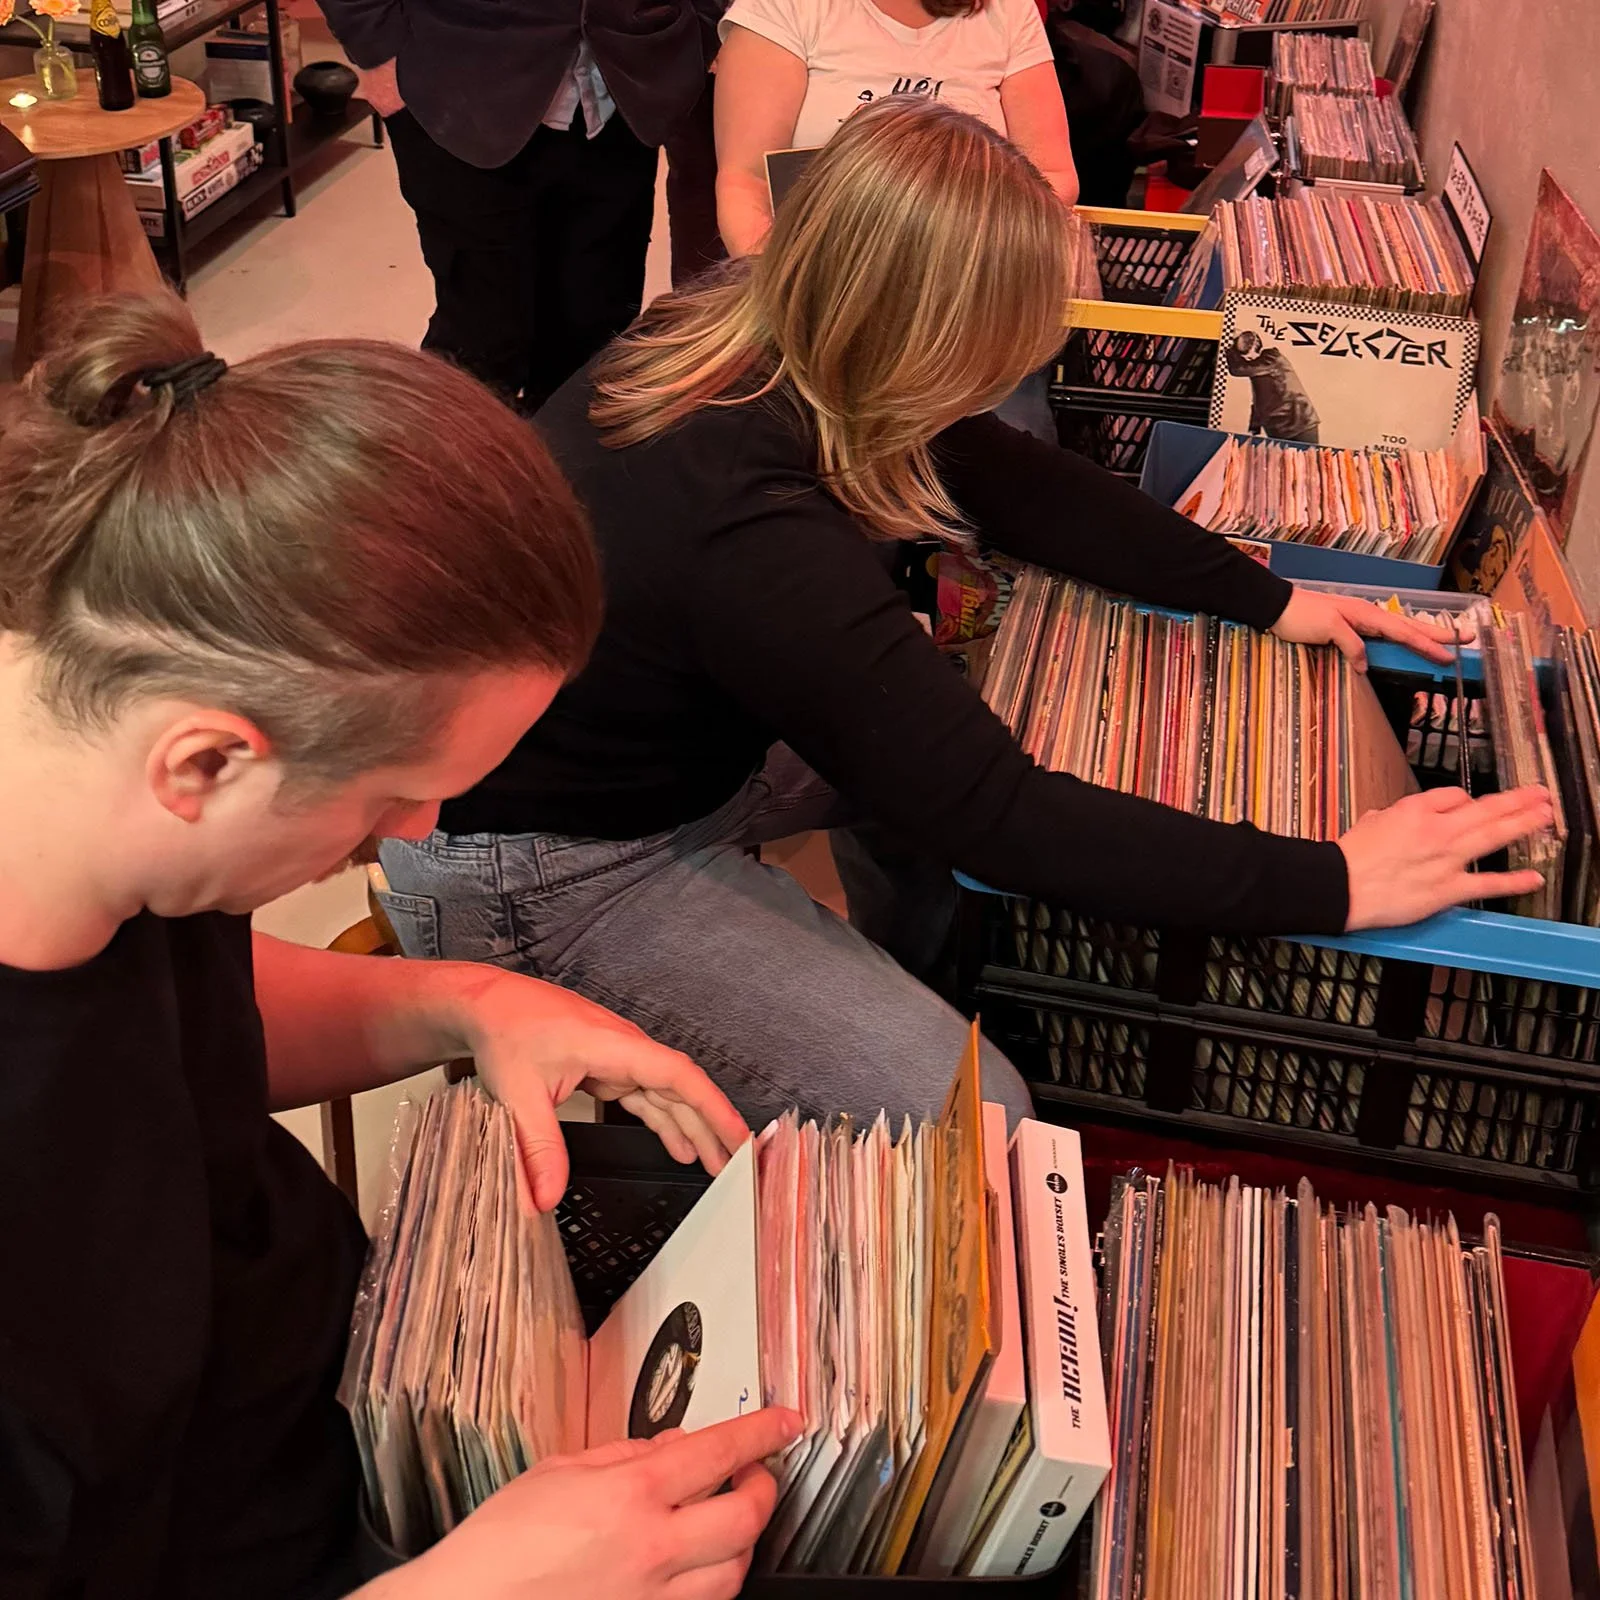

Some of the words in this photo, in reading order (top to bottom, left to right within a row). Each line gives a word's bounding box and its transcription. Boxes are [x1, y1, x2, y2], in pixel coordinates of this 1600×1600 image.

[1256, 314, 1288, 341] THE
[1287, 321, 1453, 369] SELECTER
[1382, 434, 1407, 445] TOO
[1053, 1196, 1066, 1234] BOXSET
[1056, 1235, 1069, 1277] SINGLES
[1060, 1278, 1071, 1299] THE
[1070, 1405, 1082, 1430] THE
